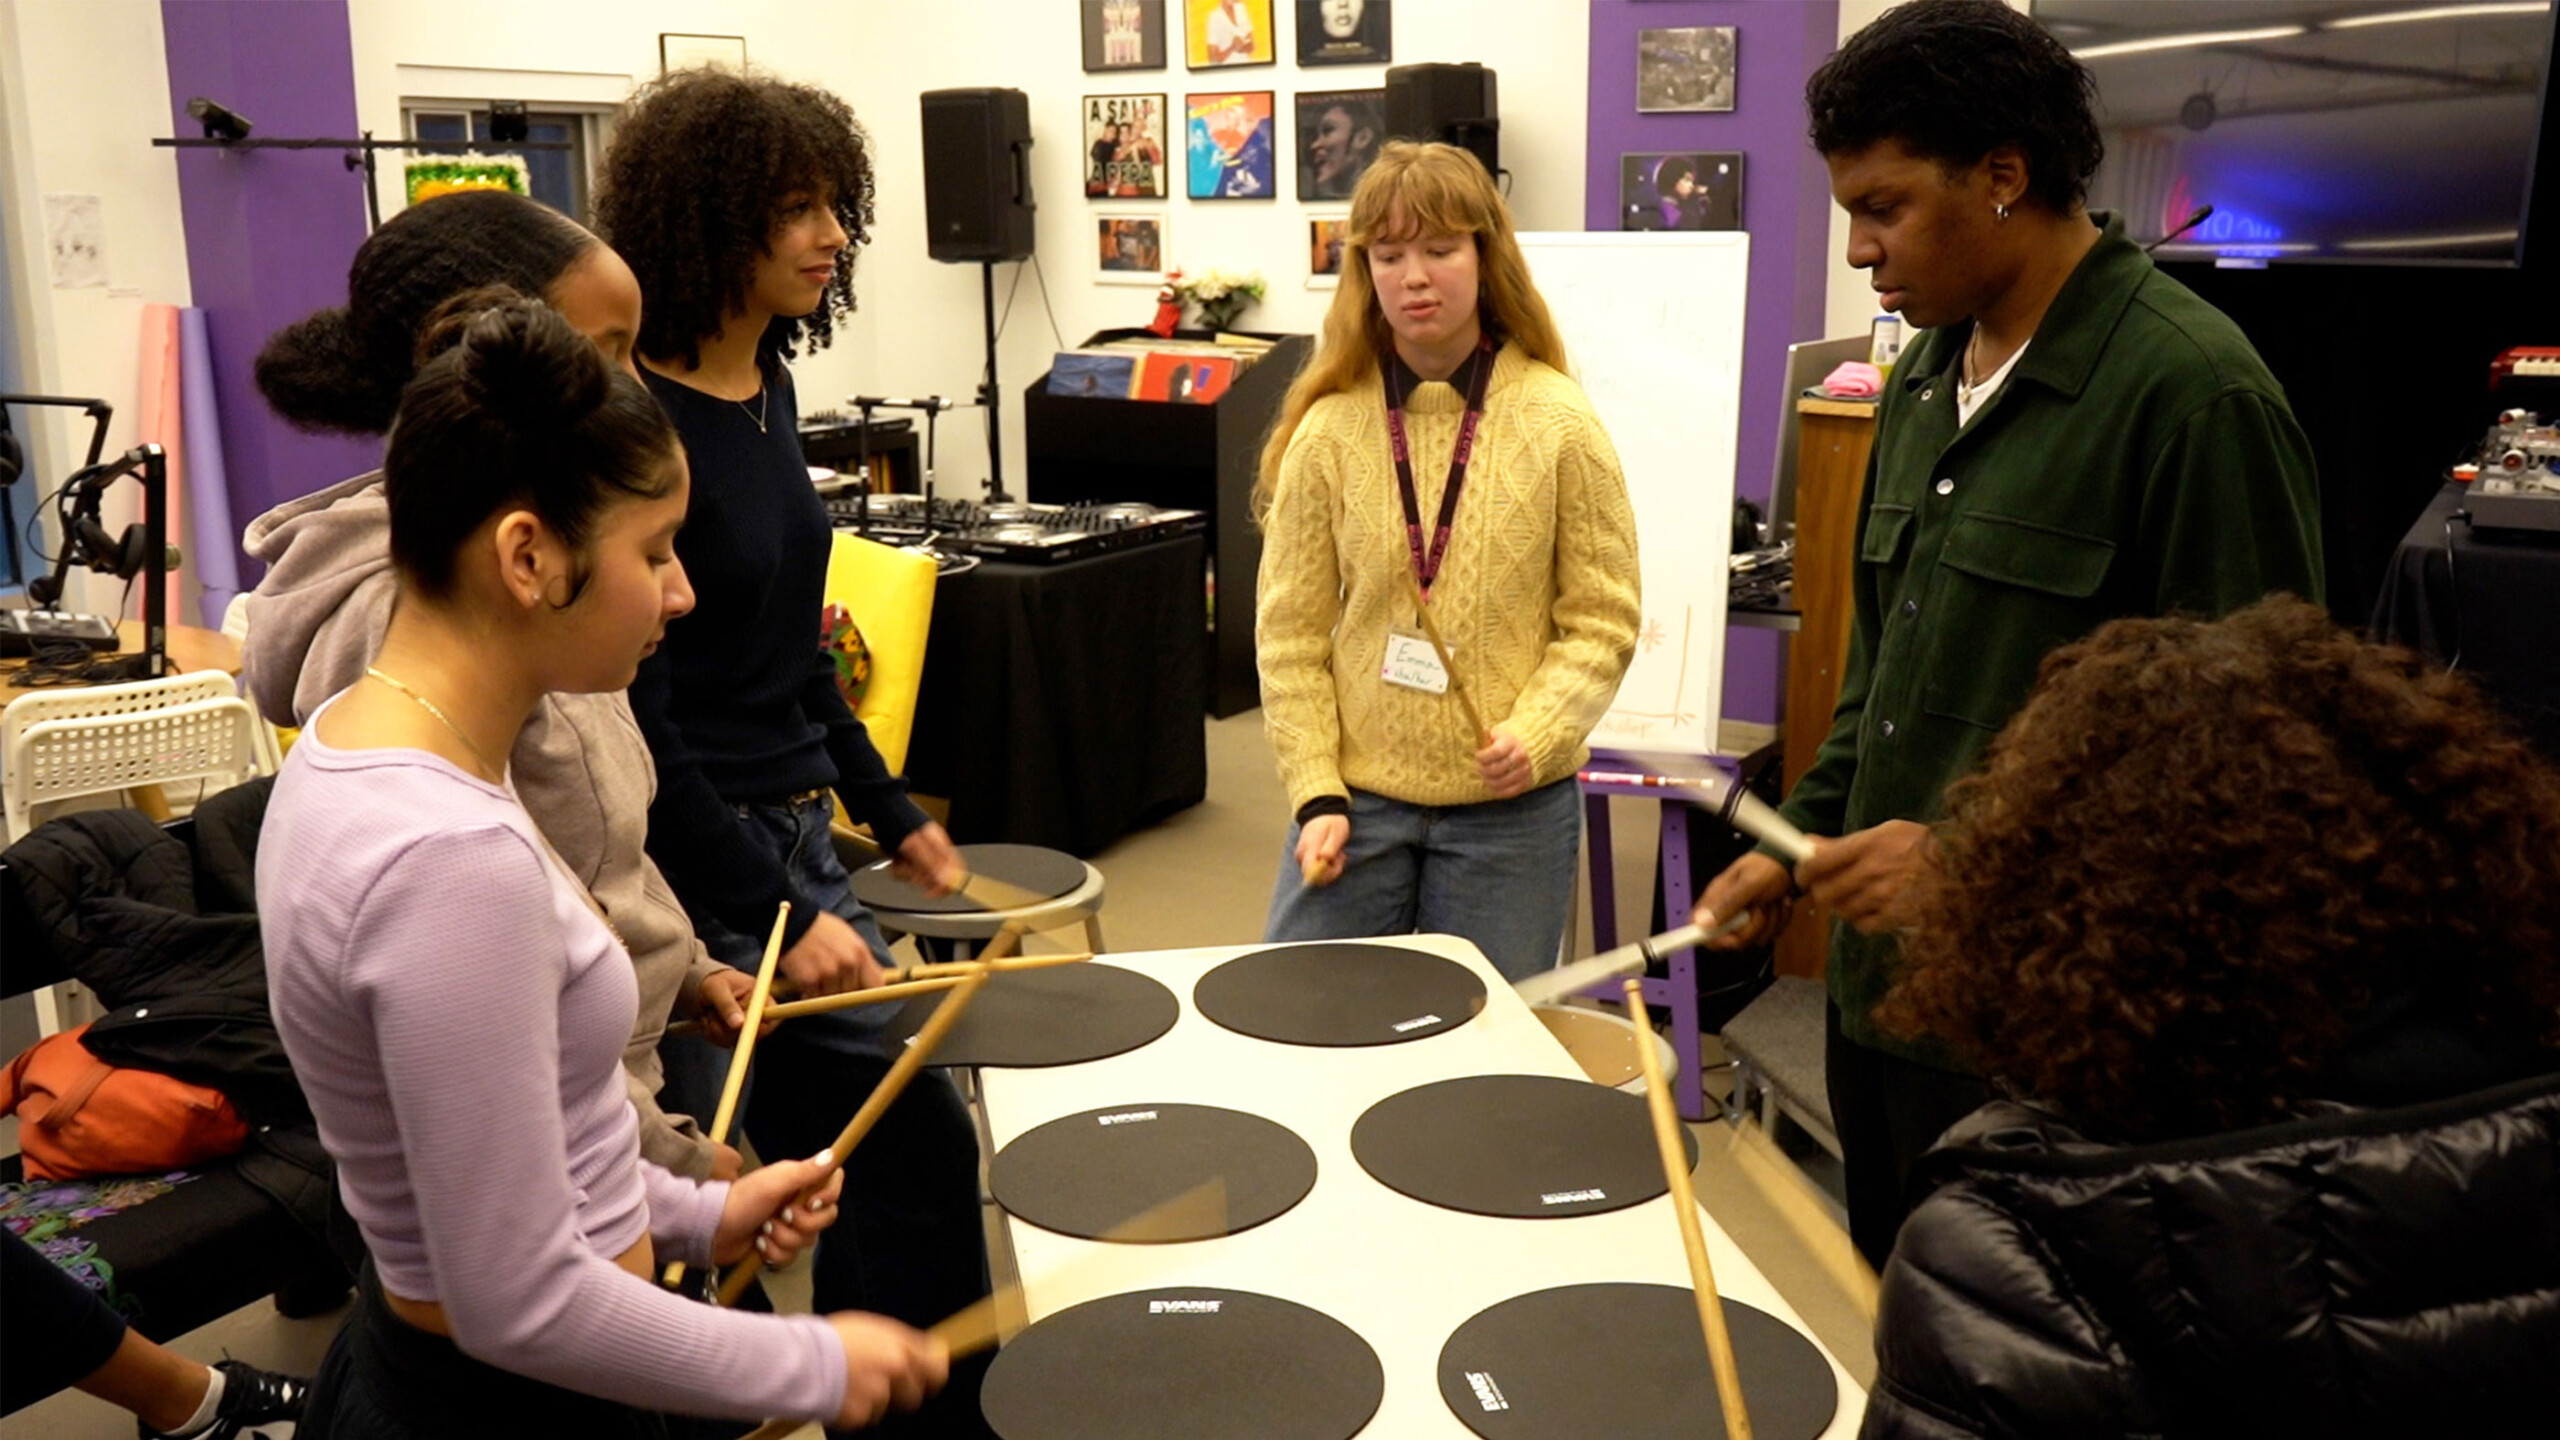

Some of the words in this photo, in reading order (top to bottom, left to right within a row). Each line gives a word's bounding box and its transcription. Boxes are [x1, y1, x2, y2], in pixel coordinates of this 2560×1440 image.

[1090, 99, 1102, 121] A
[1148, 1300, 1224, 1313] EVANS
[1464, 1370, 1502, 1412] EVANS
